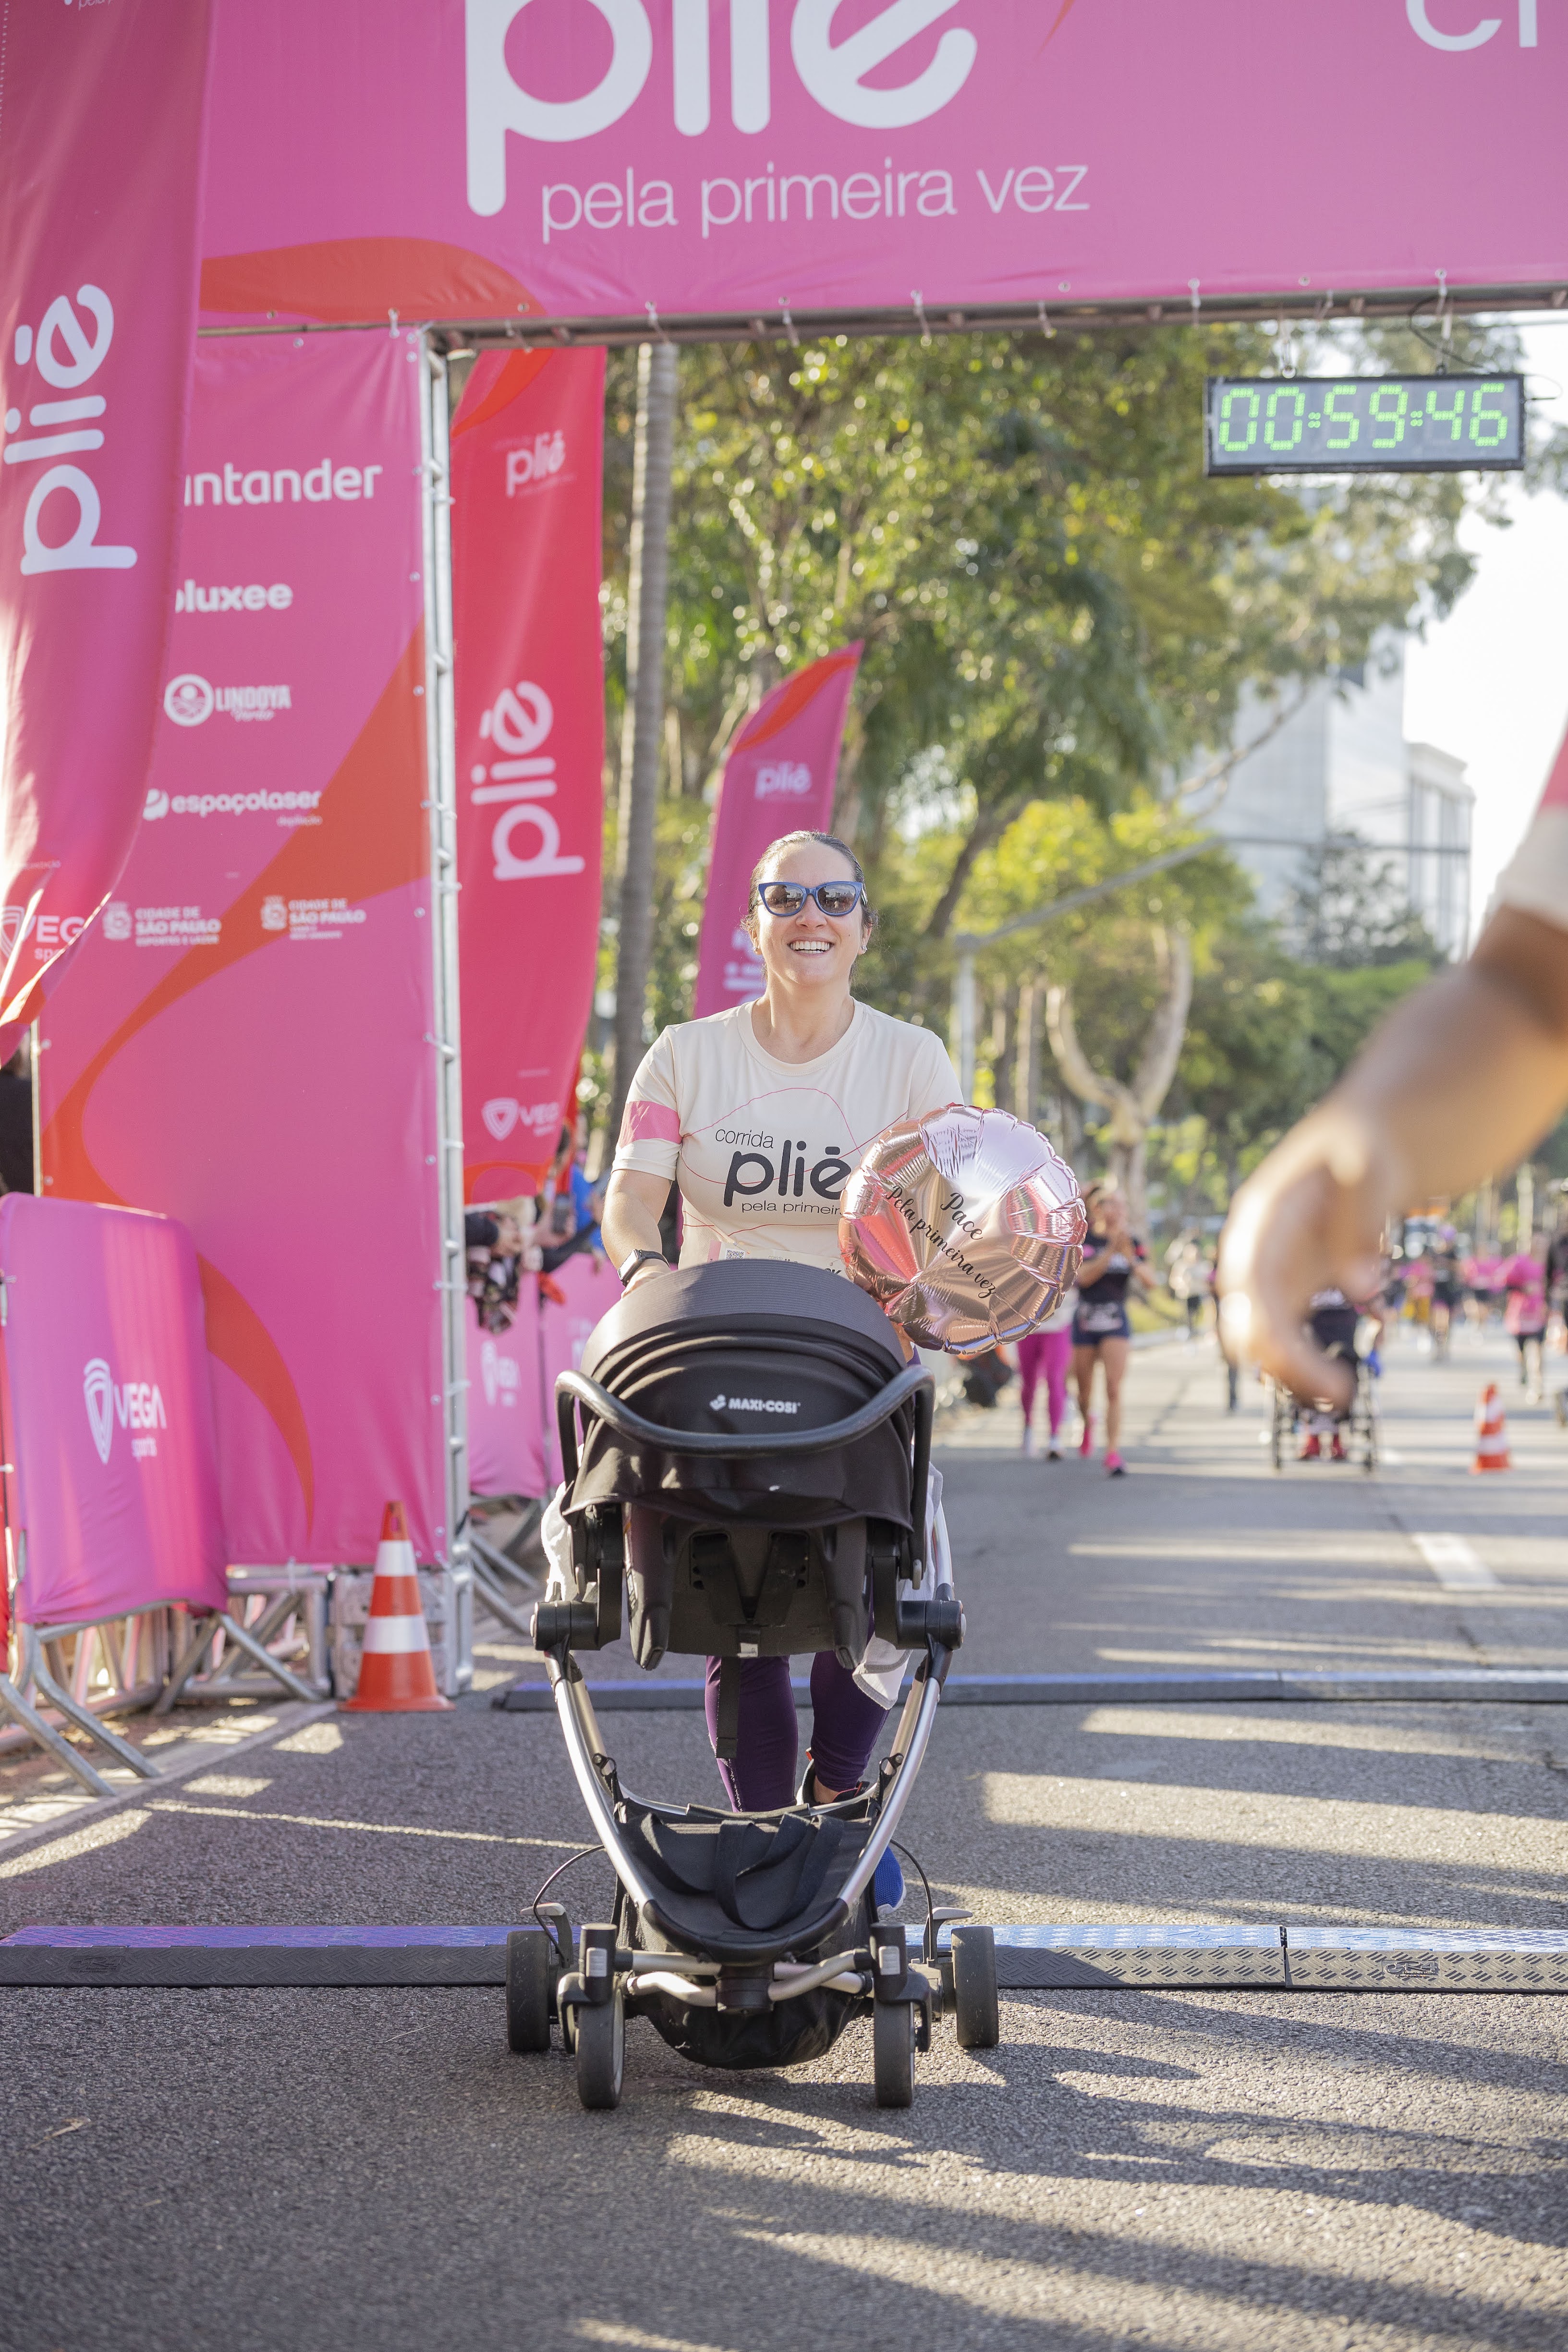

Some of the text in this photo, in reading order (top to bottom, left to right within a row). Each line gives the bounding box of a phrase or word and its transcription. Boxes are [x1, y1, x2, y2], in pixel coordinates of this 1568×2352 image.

[541, 157, 1090, 244] pela primeira vez
[1218, 383, 1507, 451] 00:59:46
[183, 458, 383, 507] ntander
[171, 788, 322, 817] espaçolaser
[715, 1129, 774, 1149] corrida
[742, 1200, 843, 1215] pela primeir
[940, 1192, 984, 1241] Pace
[885, 1185, 997, 1299] Pela primeira vez
[114, 1382, 167, 1430] VEGA
